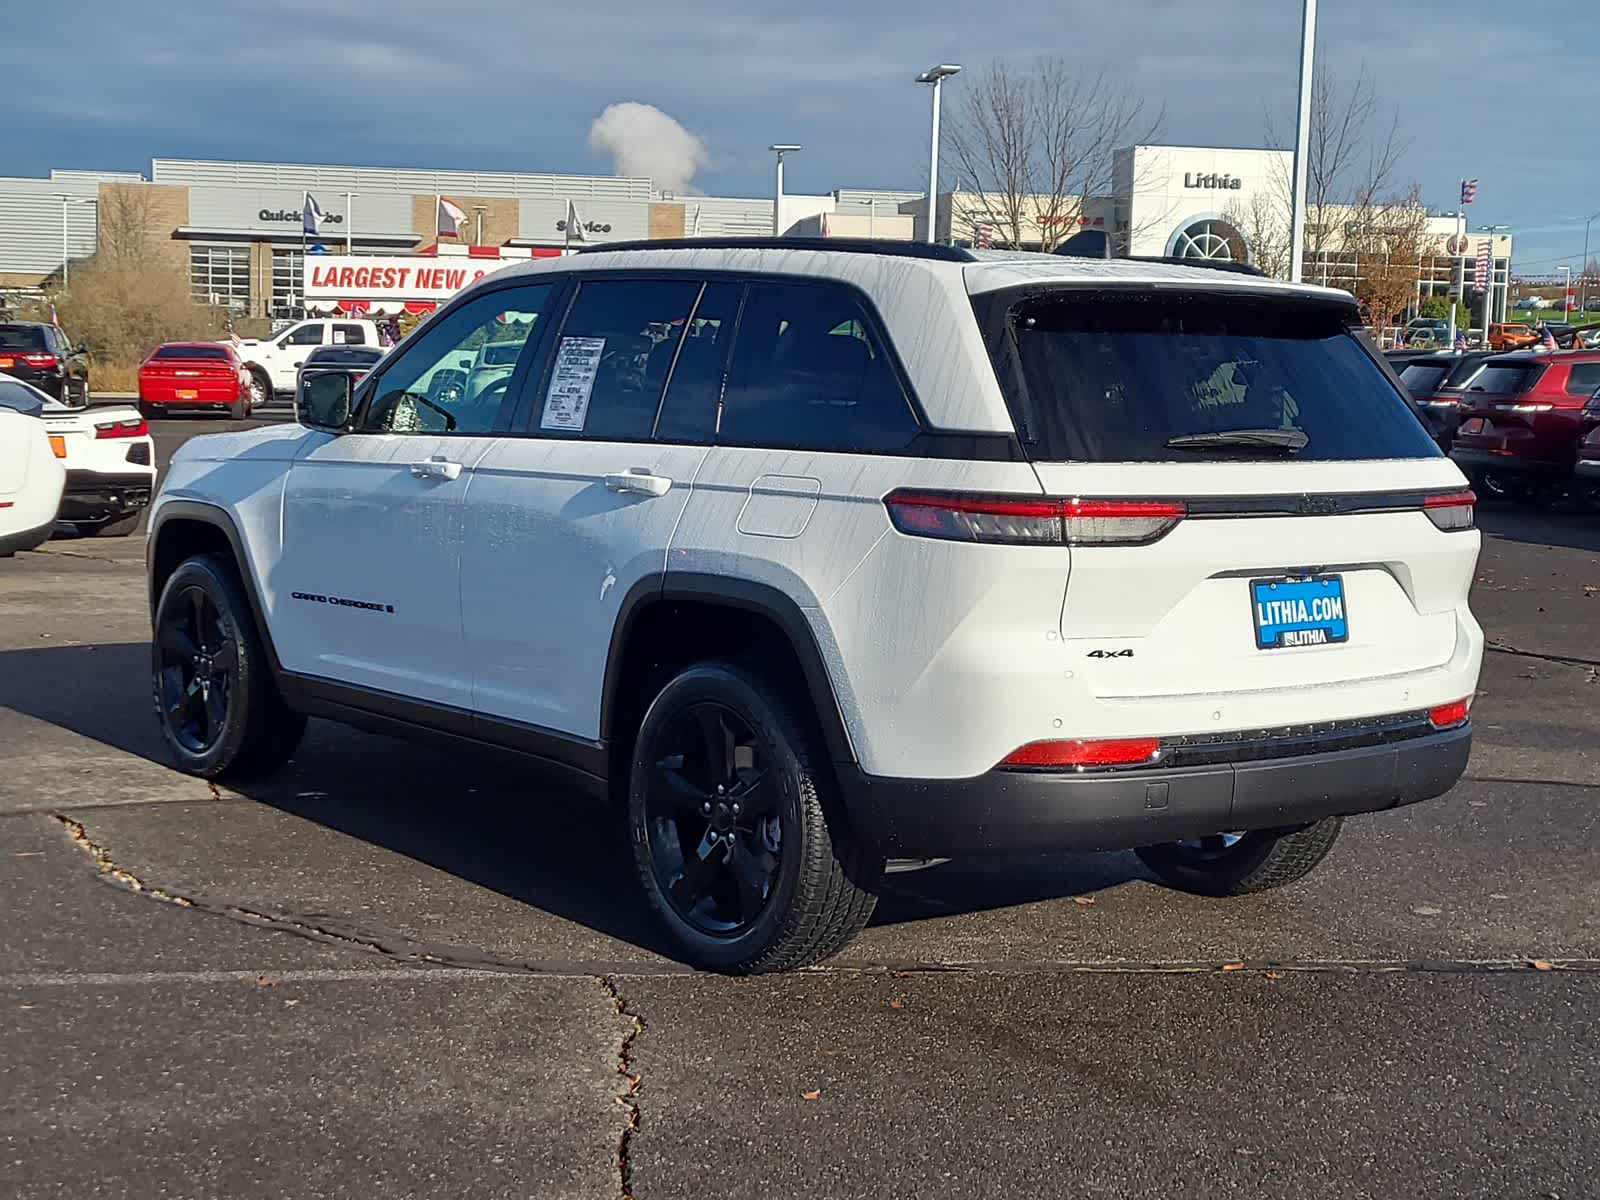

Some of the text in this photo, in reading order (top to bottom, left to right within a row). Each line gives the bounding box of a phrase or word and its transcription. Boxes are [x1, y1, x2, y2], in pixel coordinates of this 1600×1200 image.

[1184, 172, 1242, 190] Lithia
[556, 220, 612, 233] Svice
[311, 266, 411, 289] LARGEST
[415, 268, 467, 290] NEW
[1257, 596, 1344, 627] LITHIA.COM
[1295, 628, 1327, 645] LITHIA
[1086, 649, 1134, 659] 4x4
